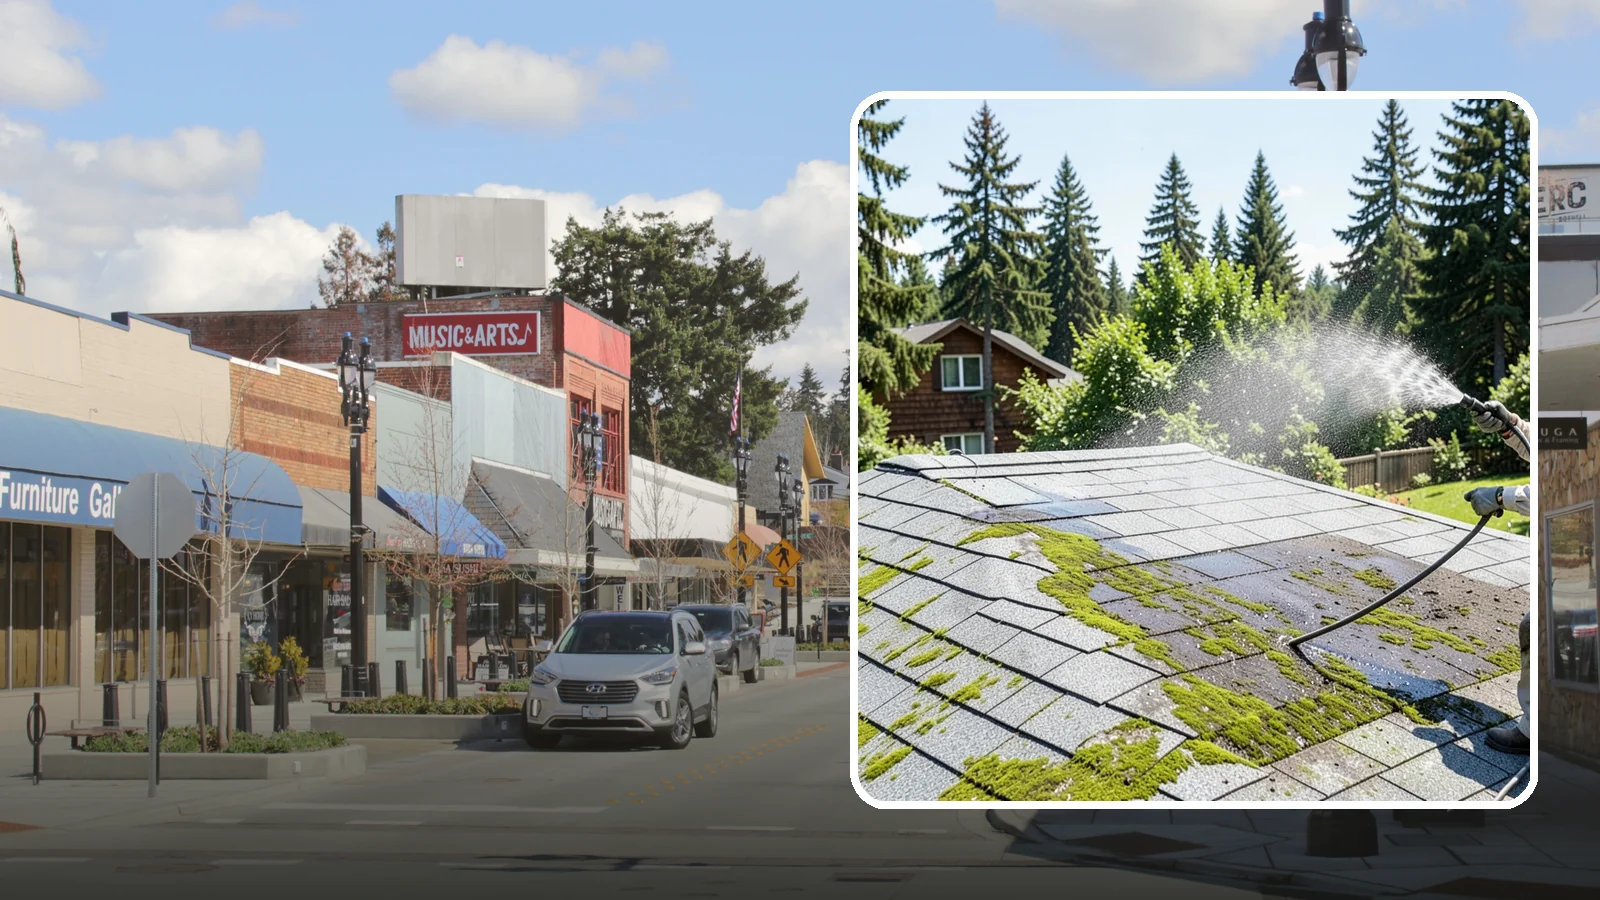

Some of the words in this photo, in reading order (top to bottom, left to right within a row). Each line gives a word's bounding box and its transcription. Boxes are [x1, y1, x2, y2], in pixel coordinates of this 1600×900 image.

[0, 471, 79, 515] Furniture
[89, 482, 122, 519] Gal
[453, 563, 479, 574] SUSHI
